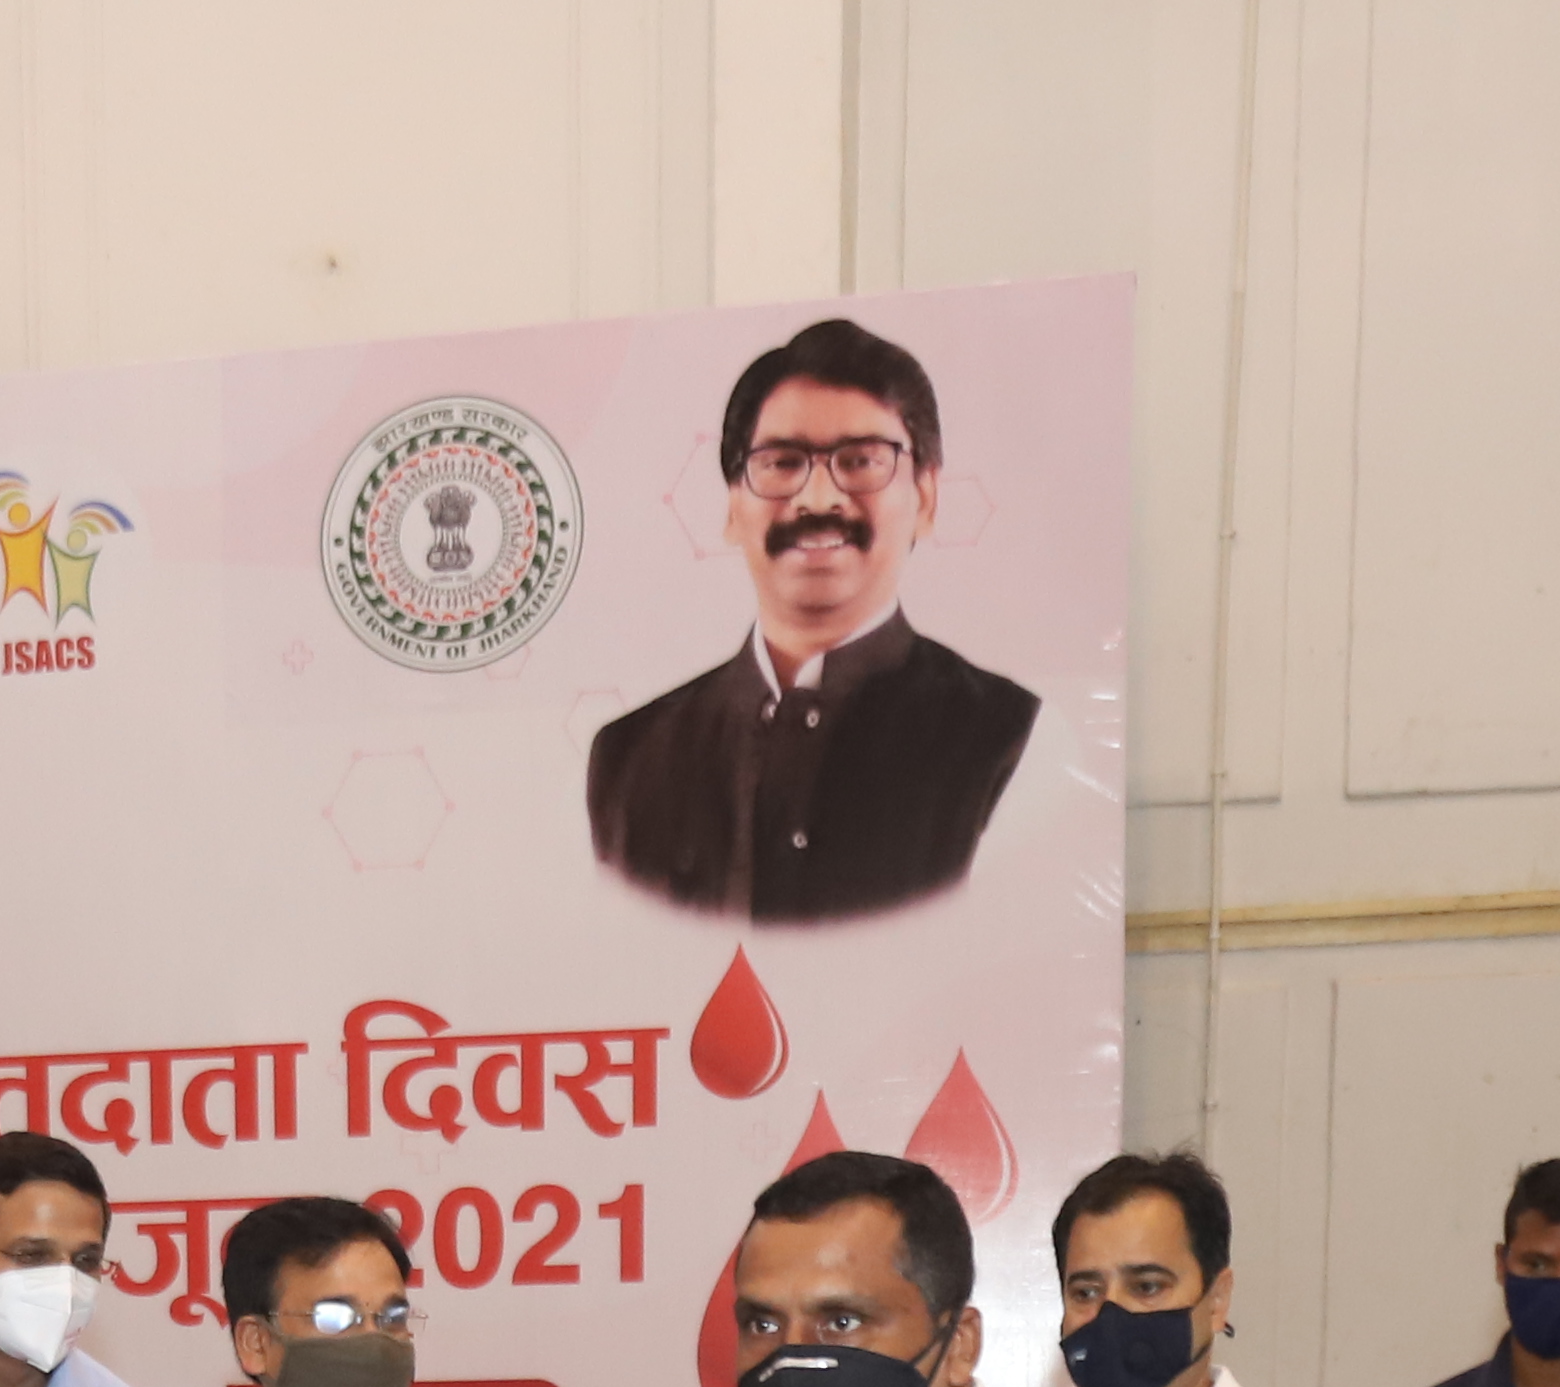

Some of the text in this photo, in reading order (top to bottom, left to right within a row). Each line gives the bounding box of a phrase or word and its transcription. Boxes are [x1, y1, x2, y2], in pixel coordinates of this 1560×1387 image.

[462, 408, 529, 442] सरकार
[1, 636, 96, 676] JSACS
[336, 547, 569, 660] GOVERNMENT OF JHARKHAND
[341, 999, 671, 1144] दिवस
[362, 1183, 645, 1291] 2021
